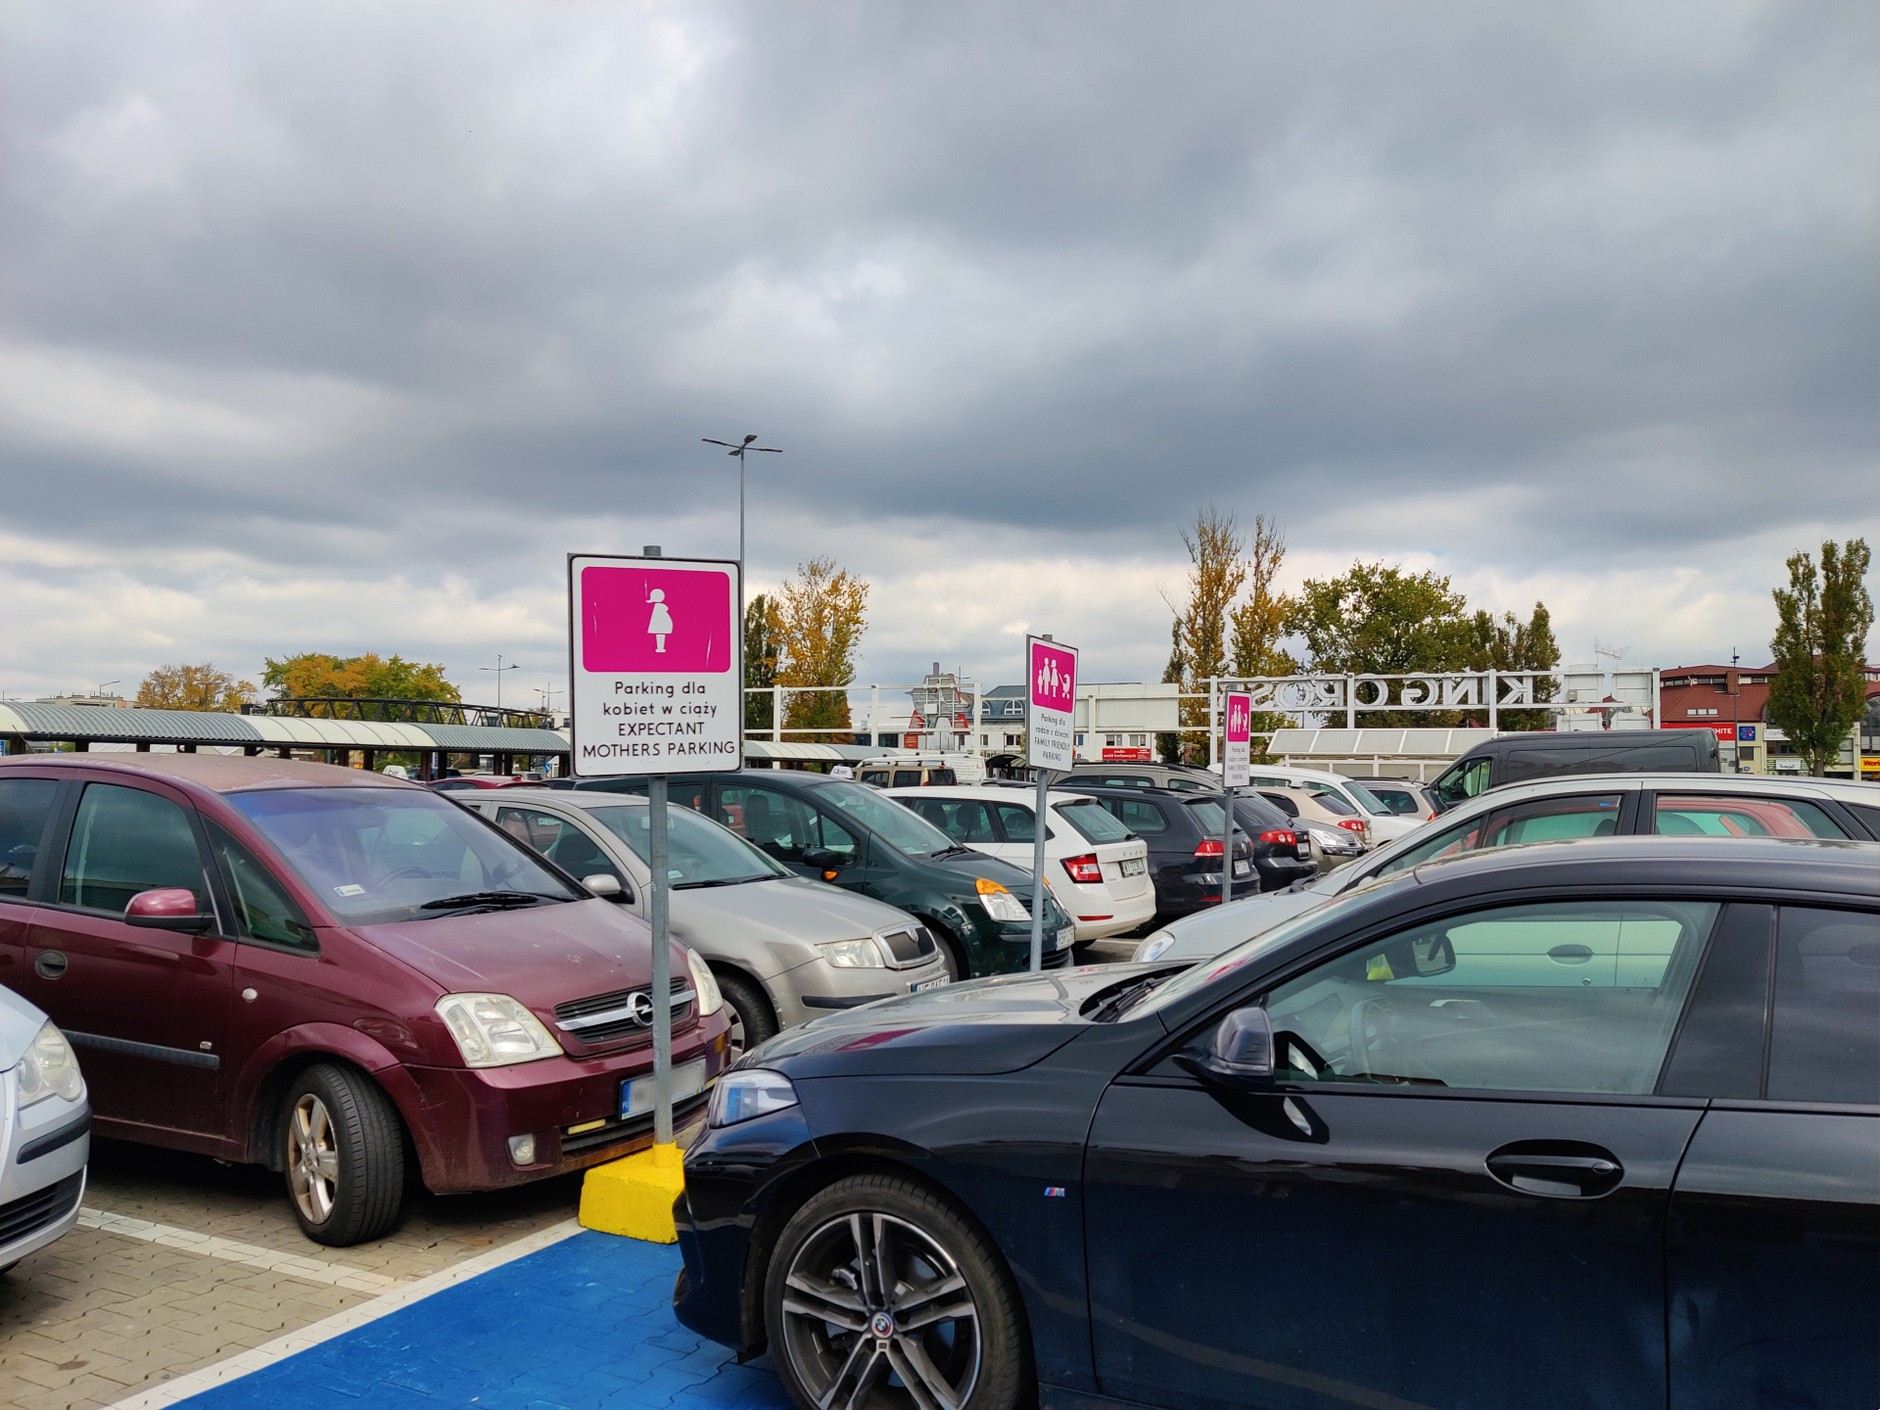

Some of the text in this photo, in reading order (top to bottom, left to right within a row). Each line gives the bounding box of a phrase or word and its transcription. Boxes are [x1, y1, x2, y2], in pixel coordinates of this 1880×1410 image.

[615, 681, 706, 698] Parking dla
[603, 701, 718, 718] kobiet w ciąży
[1041, 713, 1058, 726] Parking
[618, 721, 705, 736] EXPECTANT
[582, 740, 735, 758] MOTHERS PARKING
[1034, 736, 1070, 751] FAMILY FRIENDLY
[1042, 751, 1062, 761] PARKING
